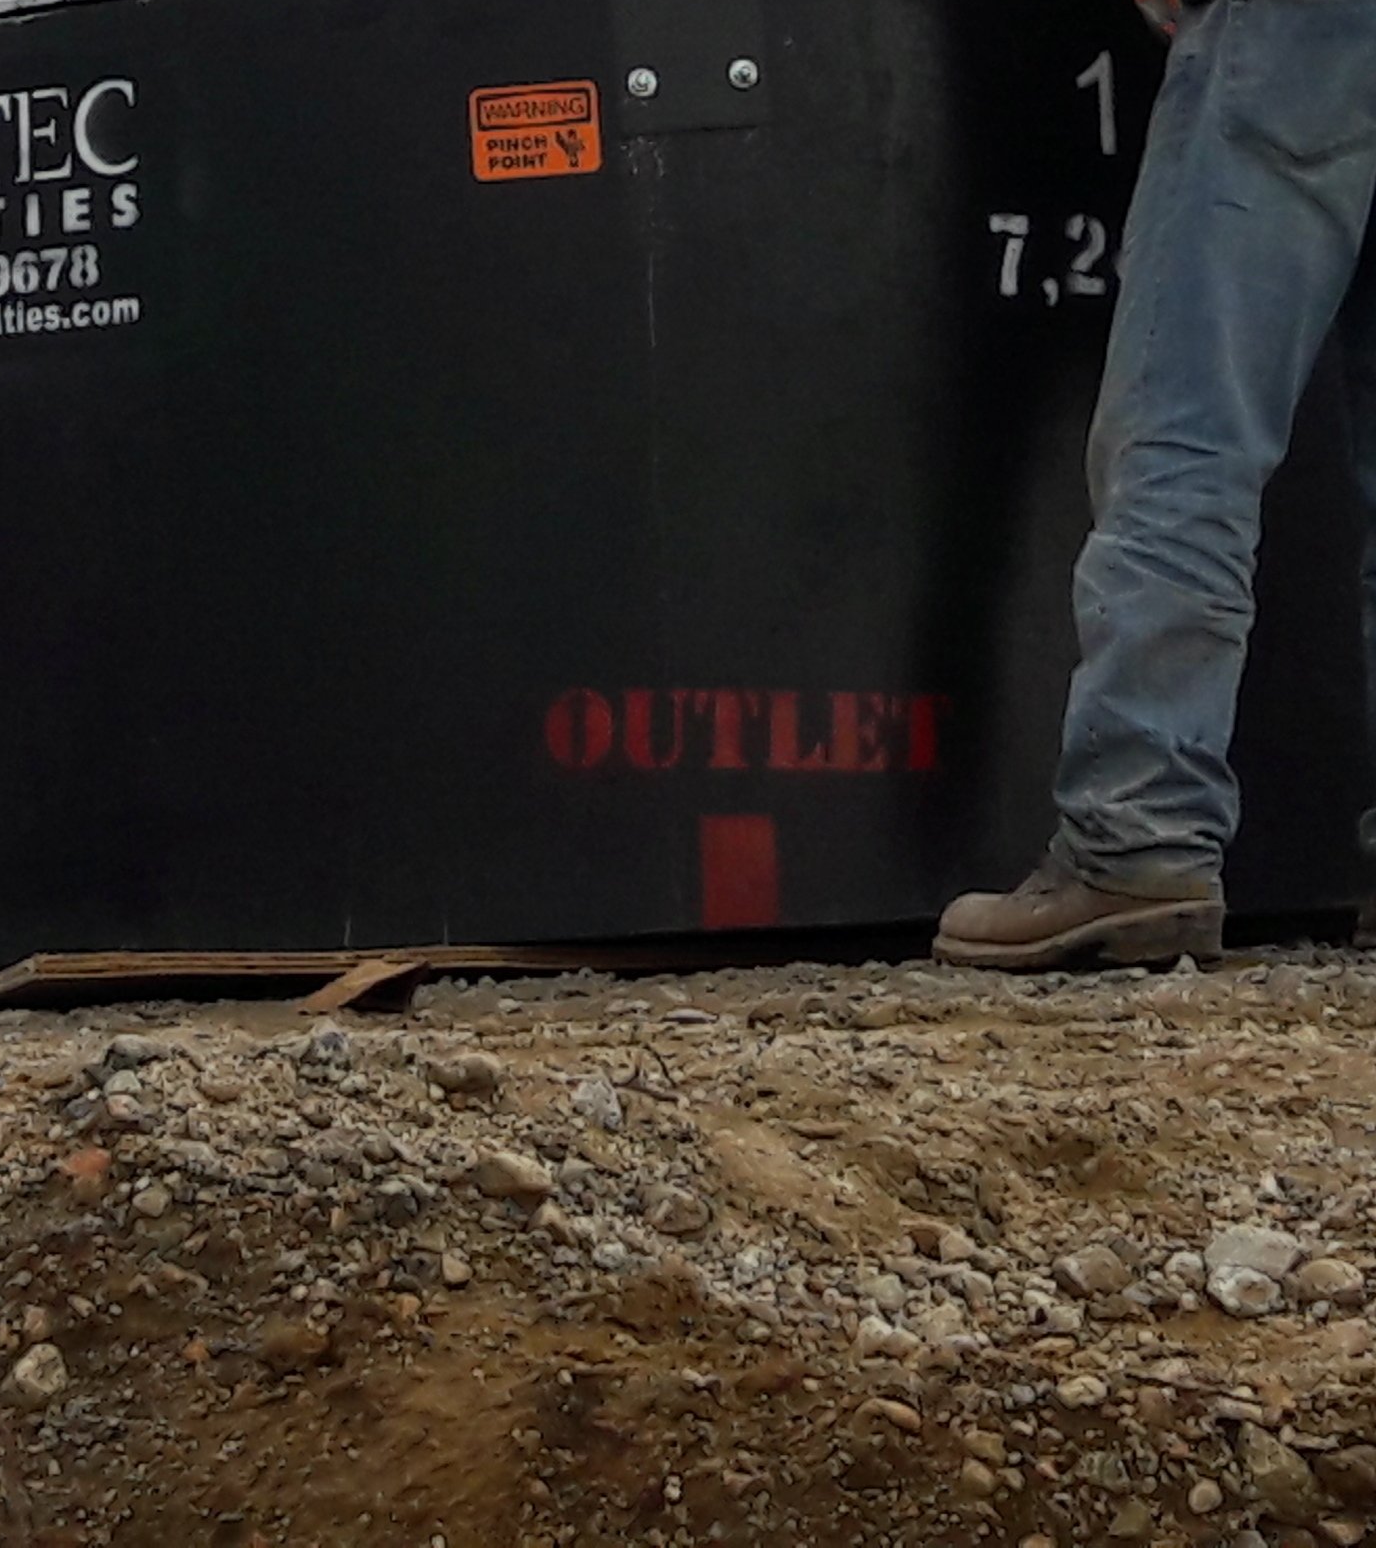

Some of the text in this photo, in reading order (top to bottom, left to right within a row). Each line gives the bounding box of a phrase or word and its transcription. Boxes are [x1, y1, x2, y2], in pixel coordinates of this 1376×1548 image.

[484, 97, 585, 122] WARNING
[486, 134, 548, 152] PINCH
[488, 153, 548, 172] POINT
[989, 213, 1106, 306] 7,2
[544, 687, 951, 770] OUTLET
